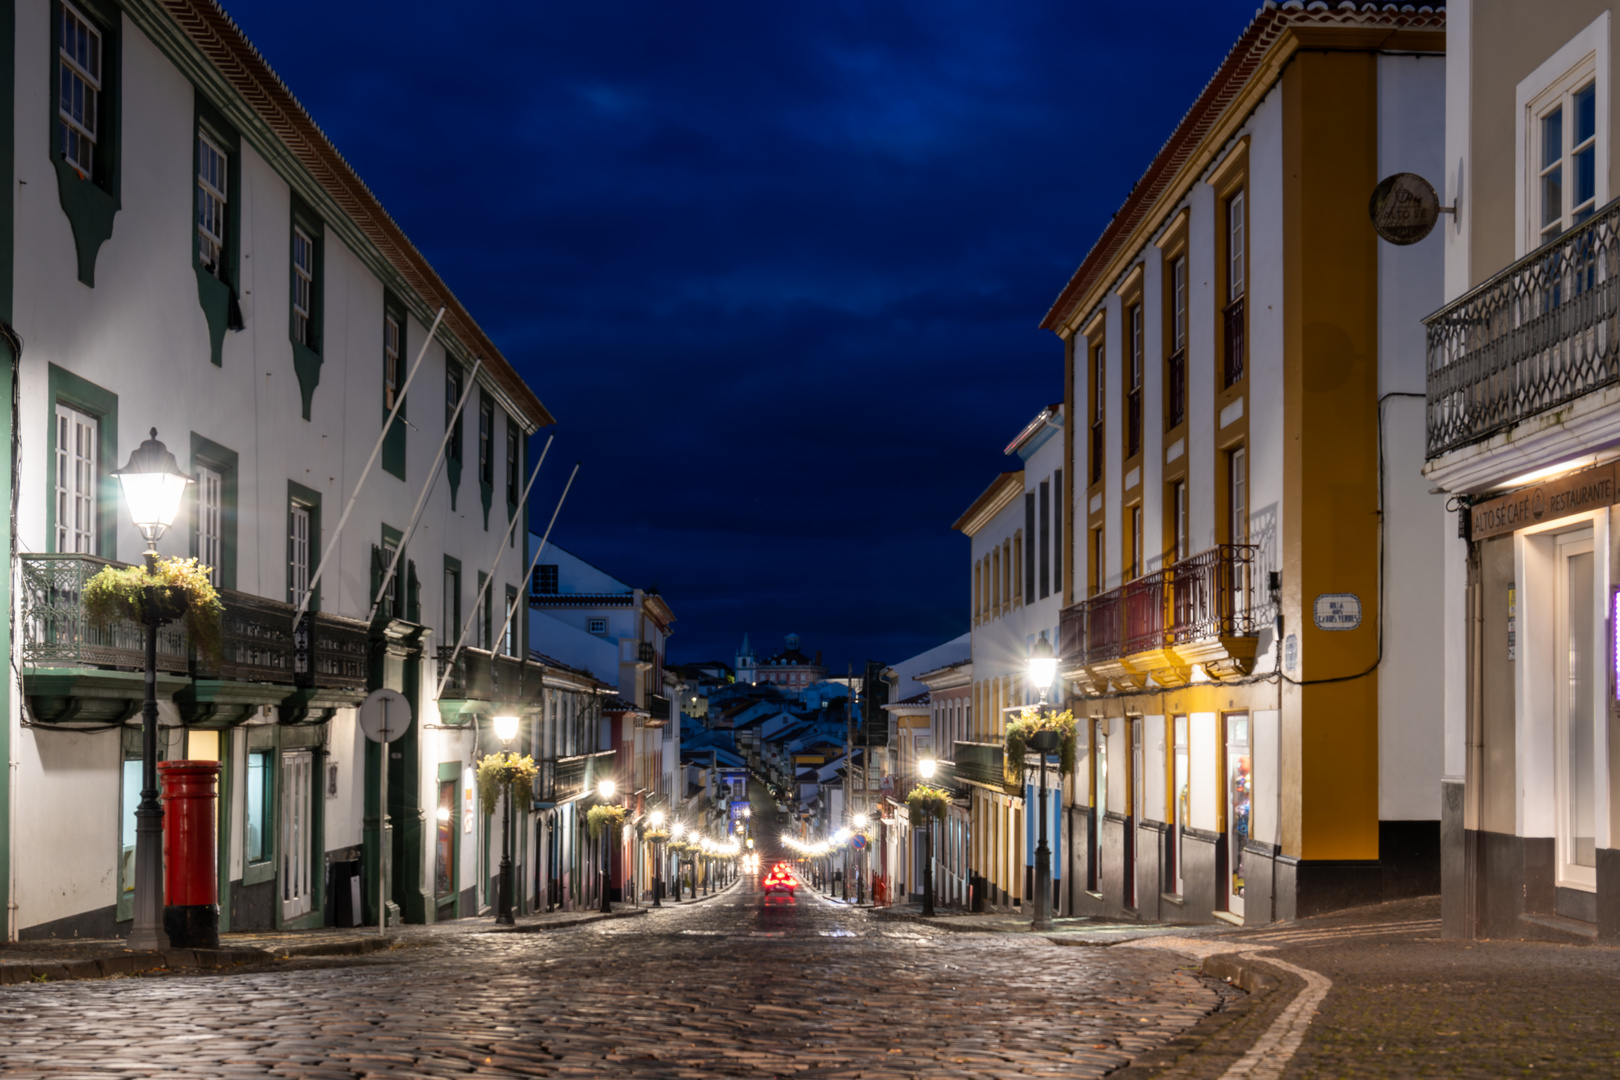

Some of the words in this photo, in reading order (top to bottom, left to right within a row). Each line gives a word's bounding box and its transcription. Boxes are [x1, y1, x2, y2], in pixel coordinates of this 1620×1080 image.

[1383, 210, 1410, 220] ALTO
[1475, 510, 1495, 534] ALTO
[1496, 503, 1506, 528] SÉ
[1507, 495, 1529, 524] CAFÉ
[1550, 479, 1610, 512] RESTAURANTE
